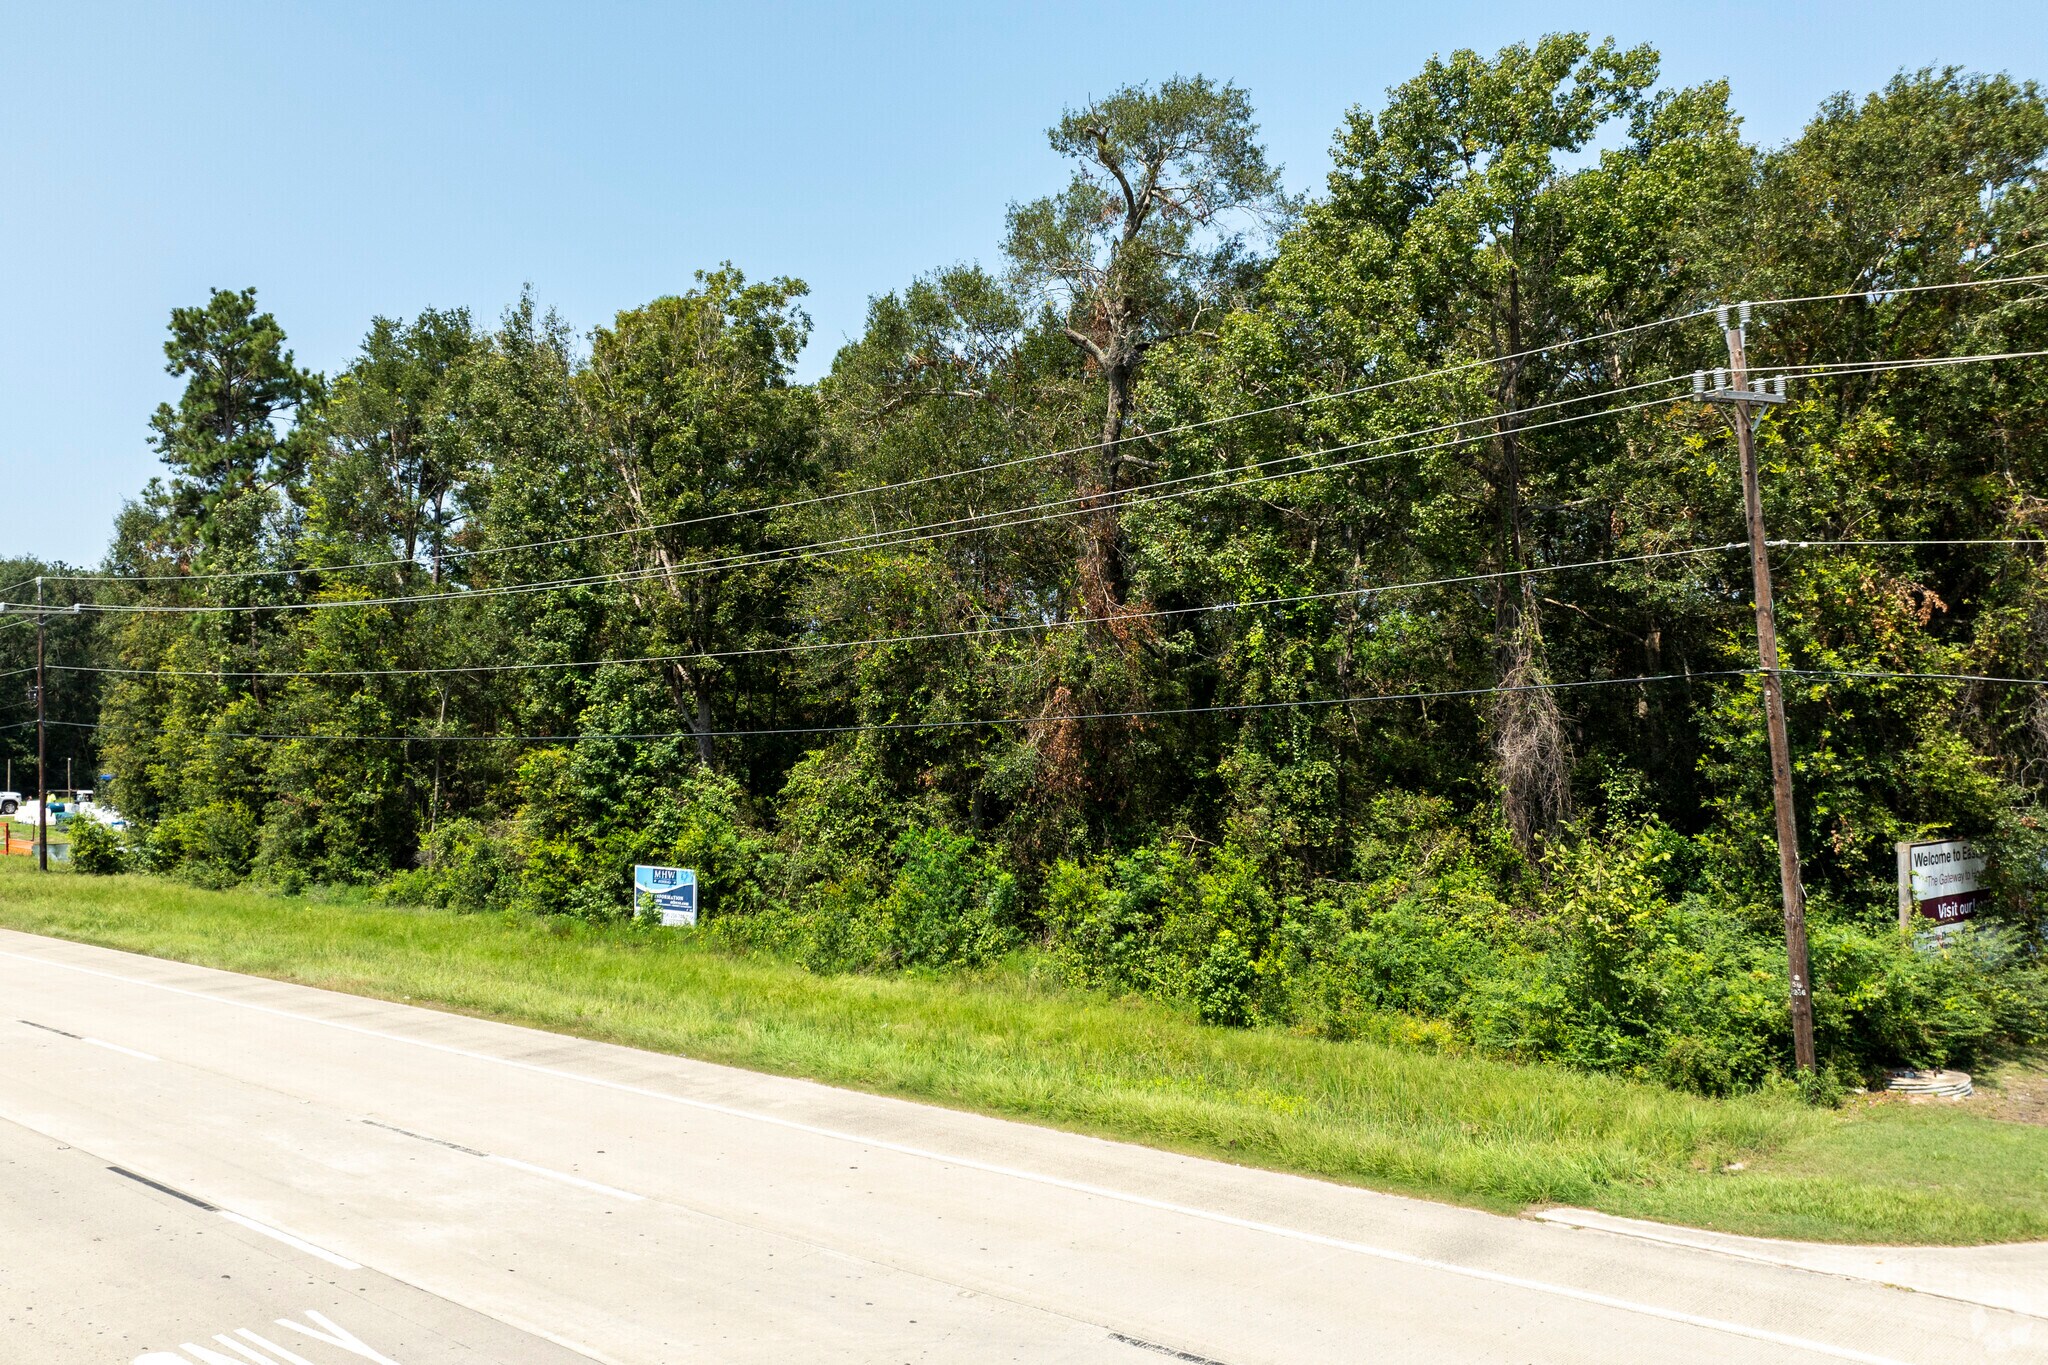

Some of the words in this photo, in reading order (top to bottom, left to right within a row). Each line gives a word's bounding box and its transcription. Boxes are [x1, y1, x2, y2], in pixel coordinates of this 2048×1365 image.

[1914, 852, 1951, 867] Welcome
[1953, 848, 1961, 861] to
[655, 870, 676, 879] MHW
[1939, 872, 1964, 885] Gateway
[1965, 870, 1971, 881] to
[1938, 901, 1958, 919] Visit
[1959, 903, 1972, 915] our
